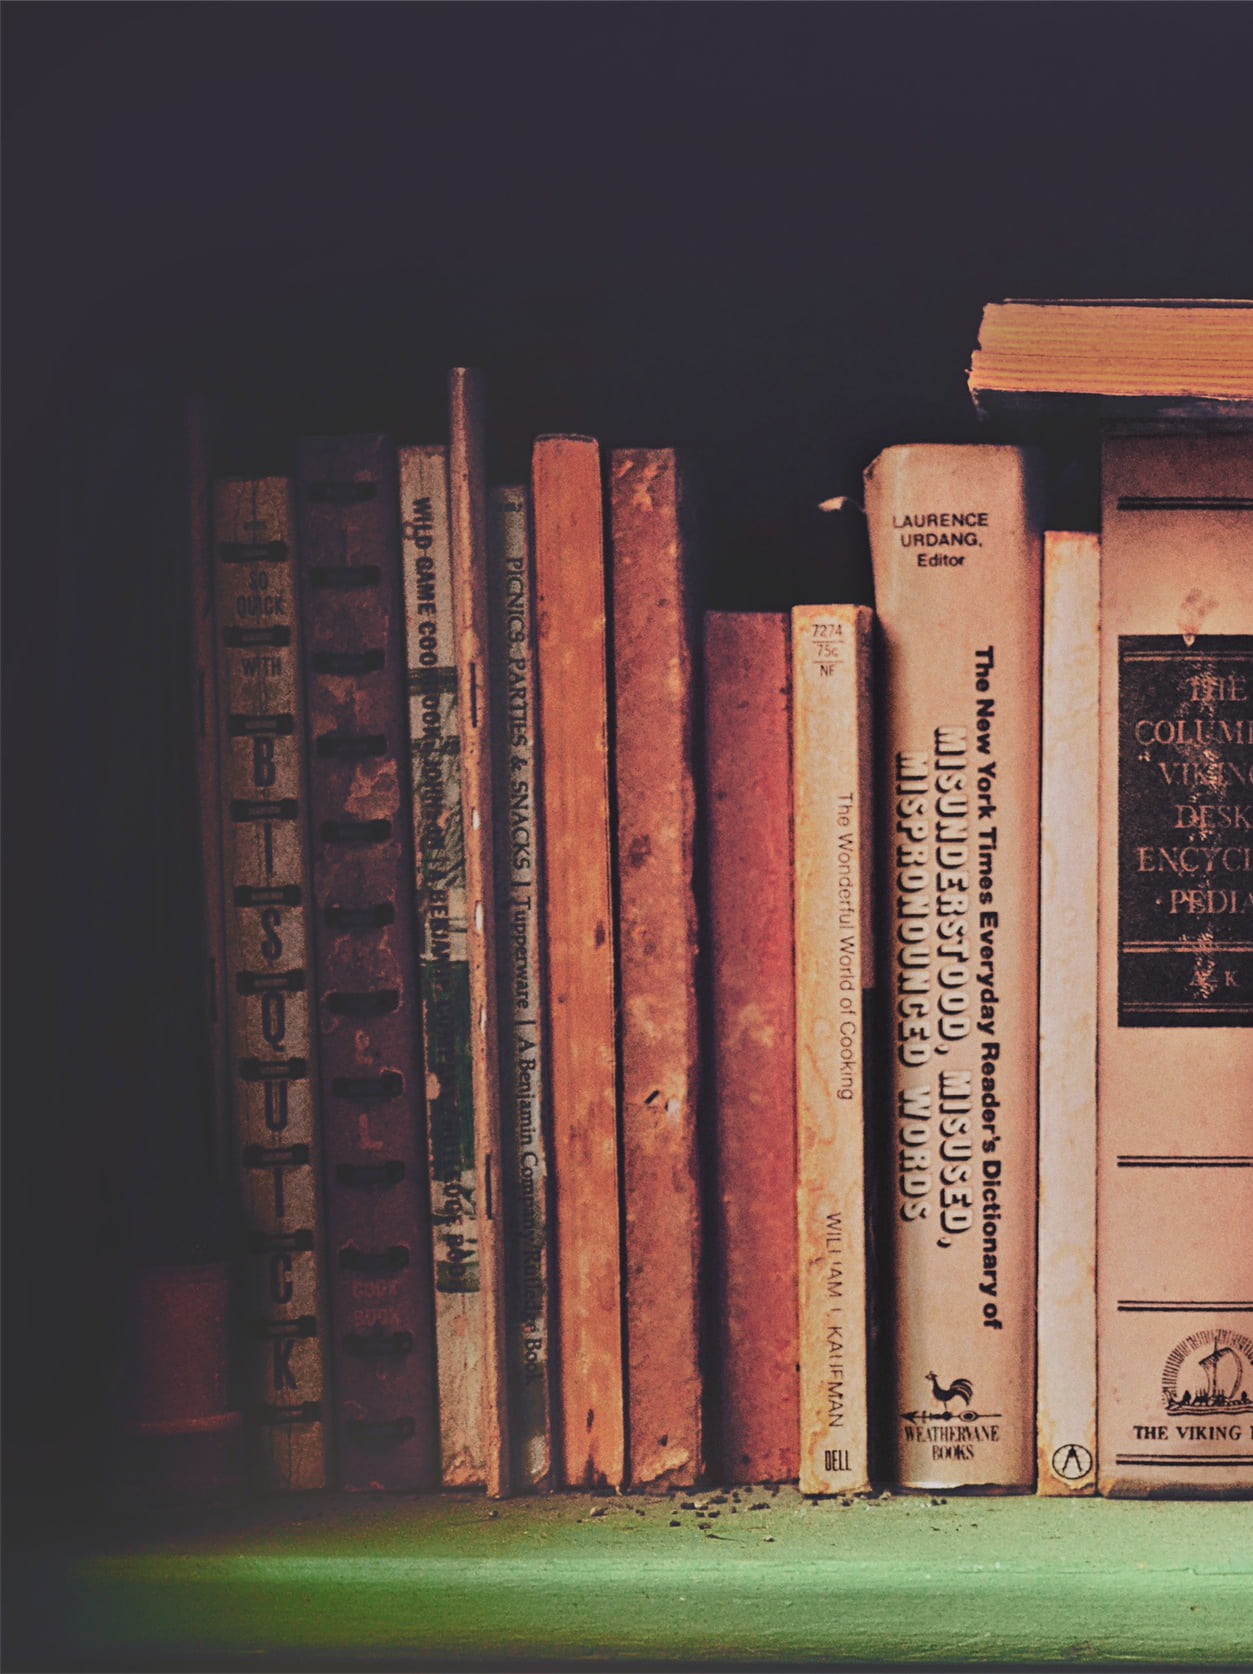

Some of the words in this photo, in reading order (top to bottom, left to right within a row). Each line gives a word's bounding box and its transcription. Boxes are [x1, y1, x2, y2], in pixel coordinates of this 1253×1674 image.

[412, 497, 432, 549] WILD
[892, 512, 989, 529] LAURENCE
[415, 557, 436, 615] GAME
[917, 553, 966, 568] Editor
[812, 623, 843, 638] 7274
[820, 664, 836, 677] NF
[974, 646, 994, 692] The
[1186, 675, 1249, 702] THE
[506, 658, 528, 747] PARTIES
[975, 700, 995, 755] New
[509, 756, 527, 773] &
[976, 761, 996, 820] York
[509, 780, 531, 870] SNACKS
[837, 792, 853, 827] The
[1174, 804, 1253, 830] DESK
[836, 833, 854, 930] Wonderful
[934, 726, 969, 1055] MISUNDERSTOOD,
[976, 827, 997, 905] Times
[896, 752, 932, 1068] MISPRONOUNCED
[510, 897, 532, 1009] Tupperware
[838, 936, 855, 992] World
[975, 911, 999, 1035] Everyday
[838, 998, 855, 1016] of
[517, 1037, 536, 1053] A
[835, 1022, 856, 1101] Cooking
[514, 1058, 537, 1146] Benjamin
[979, 1042, 1000, 1154] Reader's
[897, 1085, 932, 1224] WORDS
[935, 1070, 972, 1249] MISUSED,
[978, 1160, 1001, 1297] Dictionary
[981, 1303, 1002, 1330] of
[522, 1338, 543, 1385] Book
[825, 1326, 844, 1428] KAUFMAN
[824, 1449, 852, 1472] DELL
[904, 1424, 1000, 1443] WEATHERVANE
[931, 1443, 976, 1461] BOOKS
[1133, 1424, 1169, 1442] THE
[1175, 1424, 1243, 1442] VIKING
